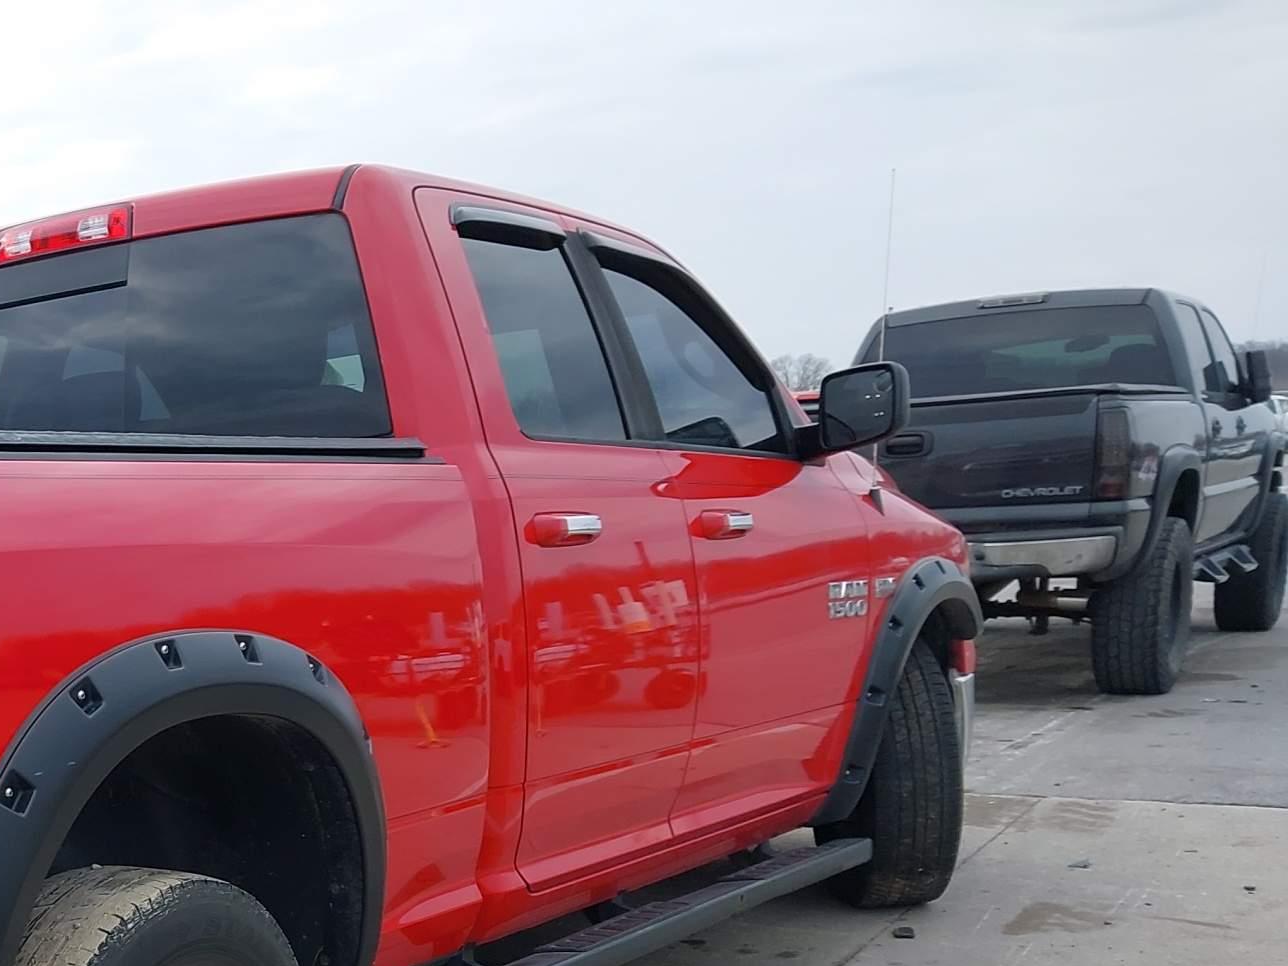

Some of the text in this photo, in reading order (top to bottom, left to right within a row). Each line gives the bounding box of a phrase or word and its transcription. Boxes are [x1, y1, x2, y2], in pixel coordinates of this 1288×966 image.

[1001, 485, 1084, 498] CHEVROLET
[827, 580, 868, 599] RAM
[827, 600, 868, 619] 1500
